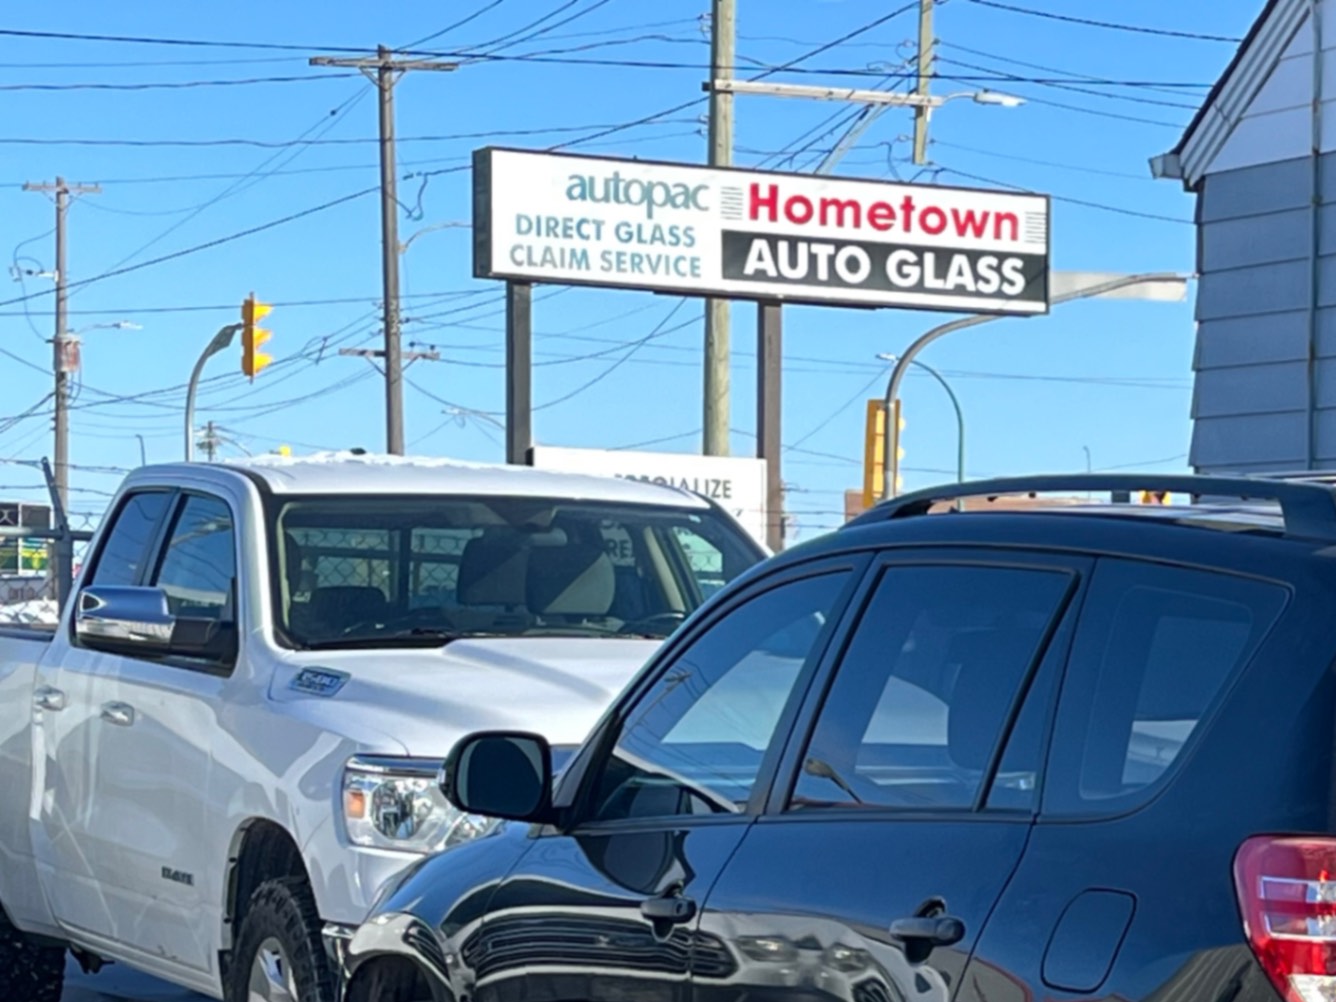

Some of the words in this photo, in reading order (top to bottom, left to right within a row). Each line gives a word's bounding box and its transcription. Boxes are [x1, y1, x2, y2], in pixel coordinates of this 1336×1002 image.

[565, 171, 710, 219] autopac
[749, 183, 1018, 241] Hometown
[516, 213, 605, 240] DIRECT
[614, 221, 696, 248] GLASS
[509, 244, 590, 271] CLAIM
[600, 250, 701, 278] SERVICE
[743, 239, 871, 284] AUTO
[885, 249, 1025, 295] GLASS
[614, 473, 732, 499] CIALIZE
